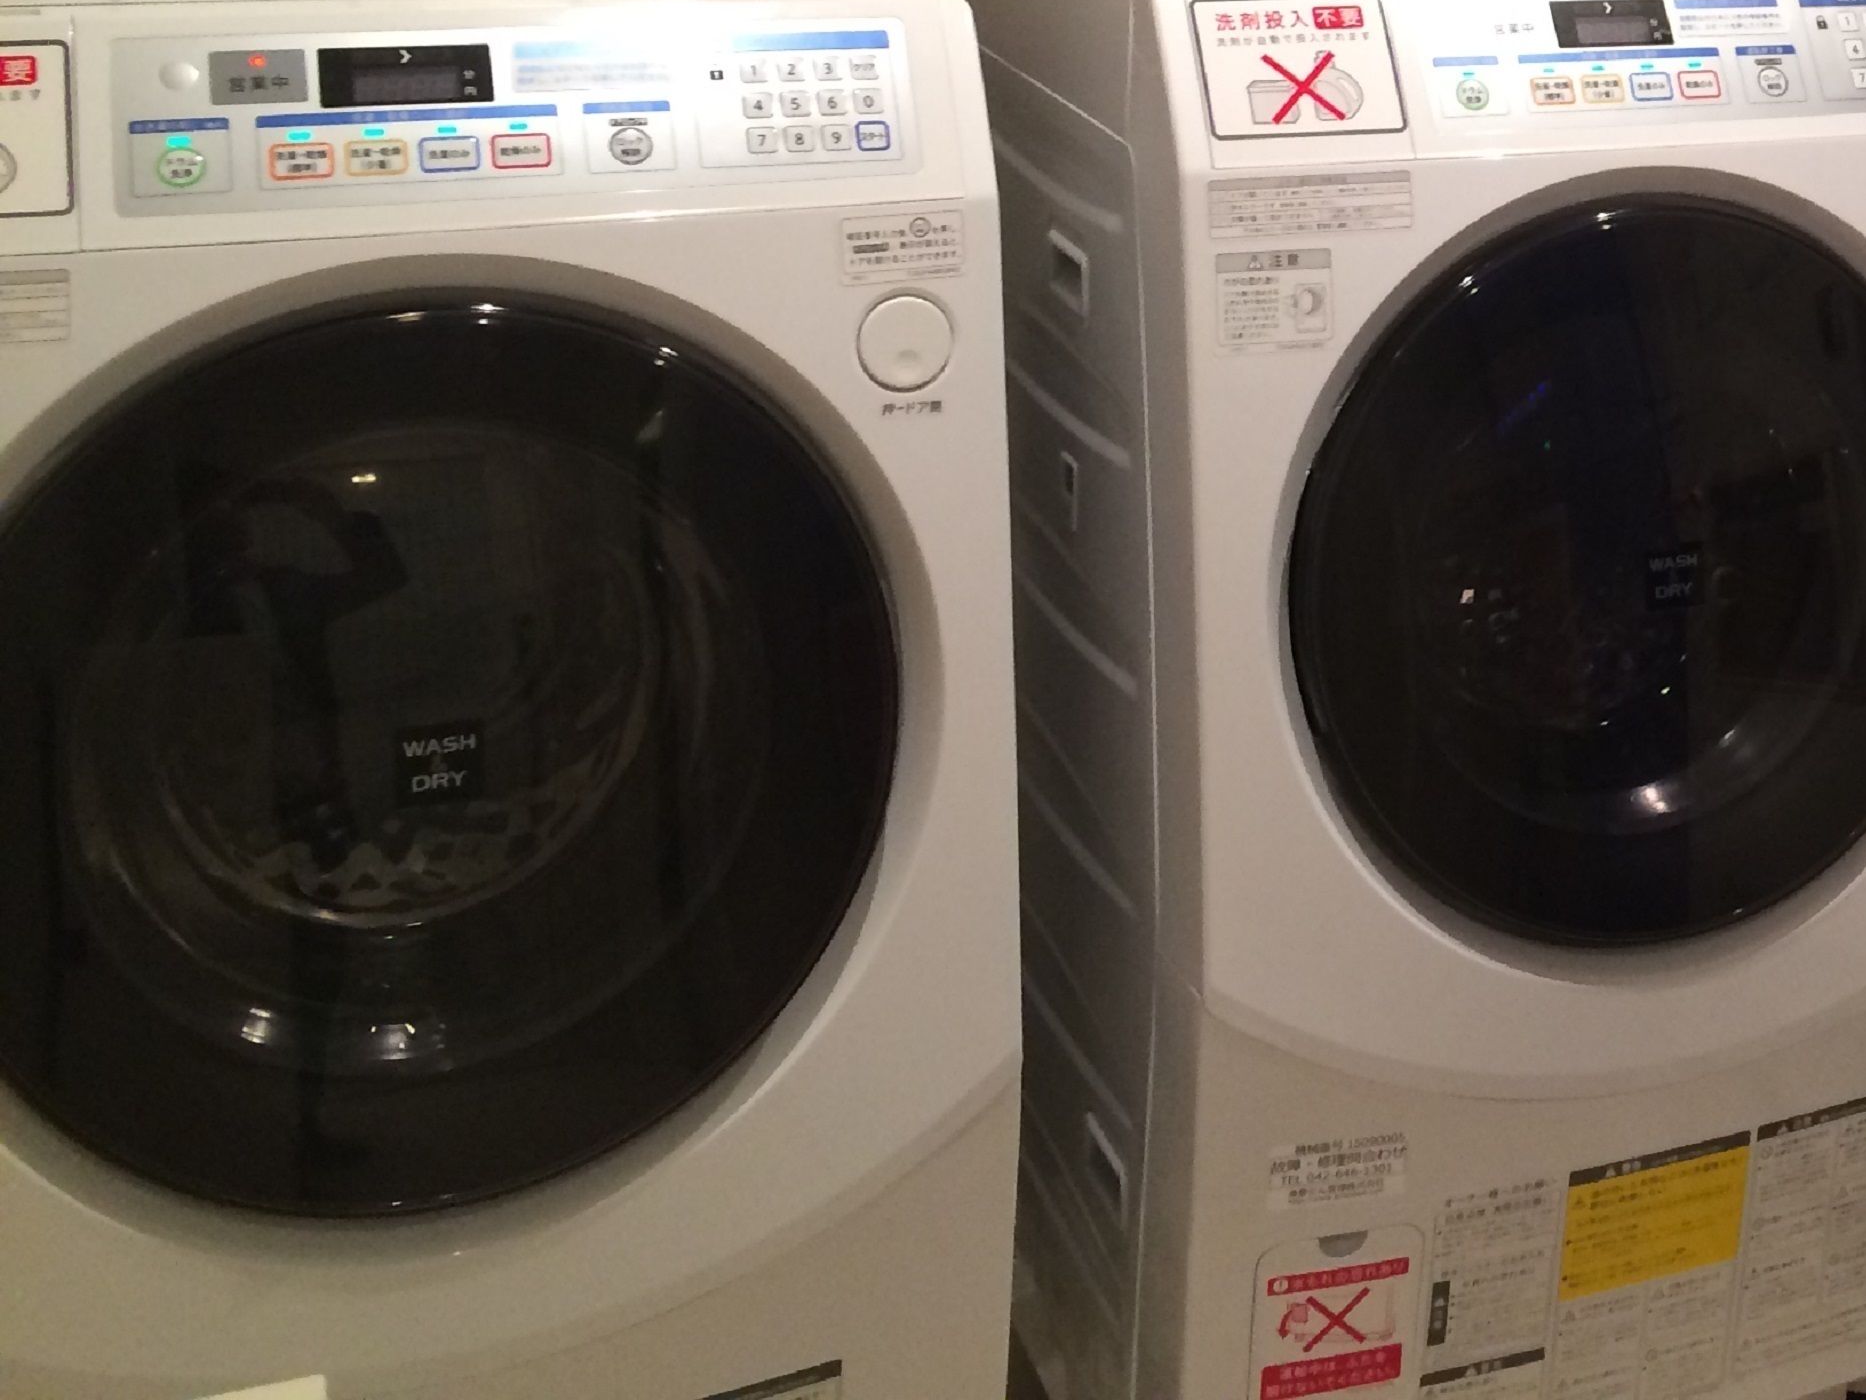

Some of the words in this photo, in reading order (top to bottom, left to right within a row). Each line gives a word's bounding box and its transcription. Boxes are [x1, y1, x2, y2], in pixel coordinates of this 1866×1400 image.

[1215, 10, 1309, 31] 洗剤投入
[1315, 8, 1361, 27] 不要
[1649, 552, 1699, 572] WASH
[1655, 581, 1694, 600] DRY
[403, 733, 476, 758] WASH
[411, 770, 467, 794] DRY
